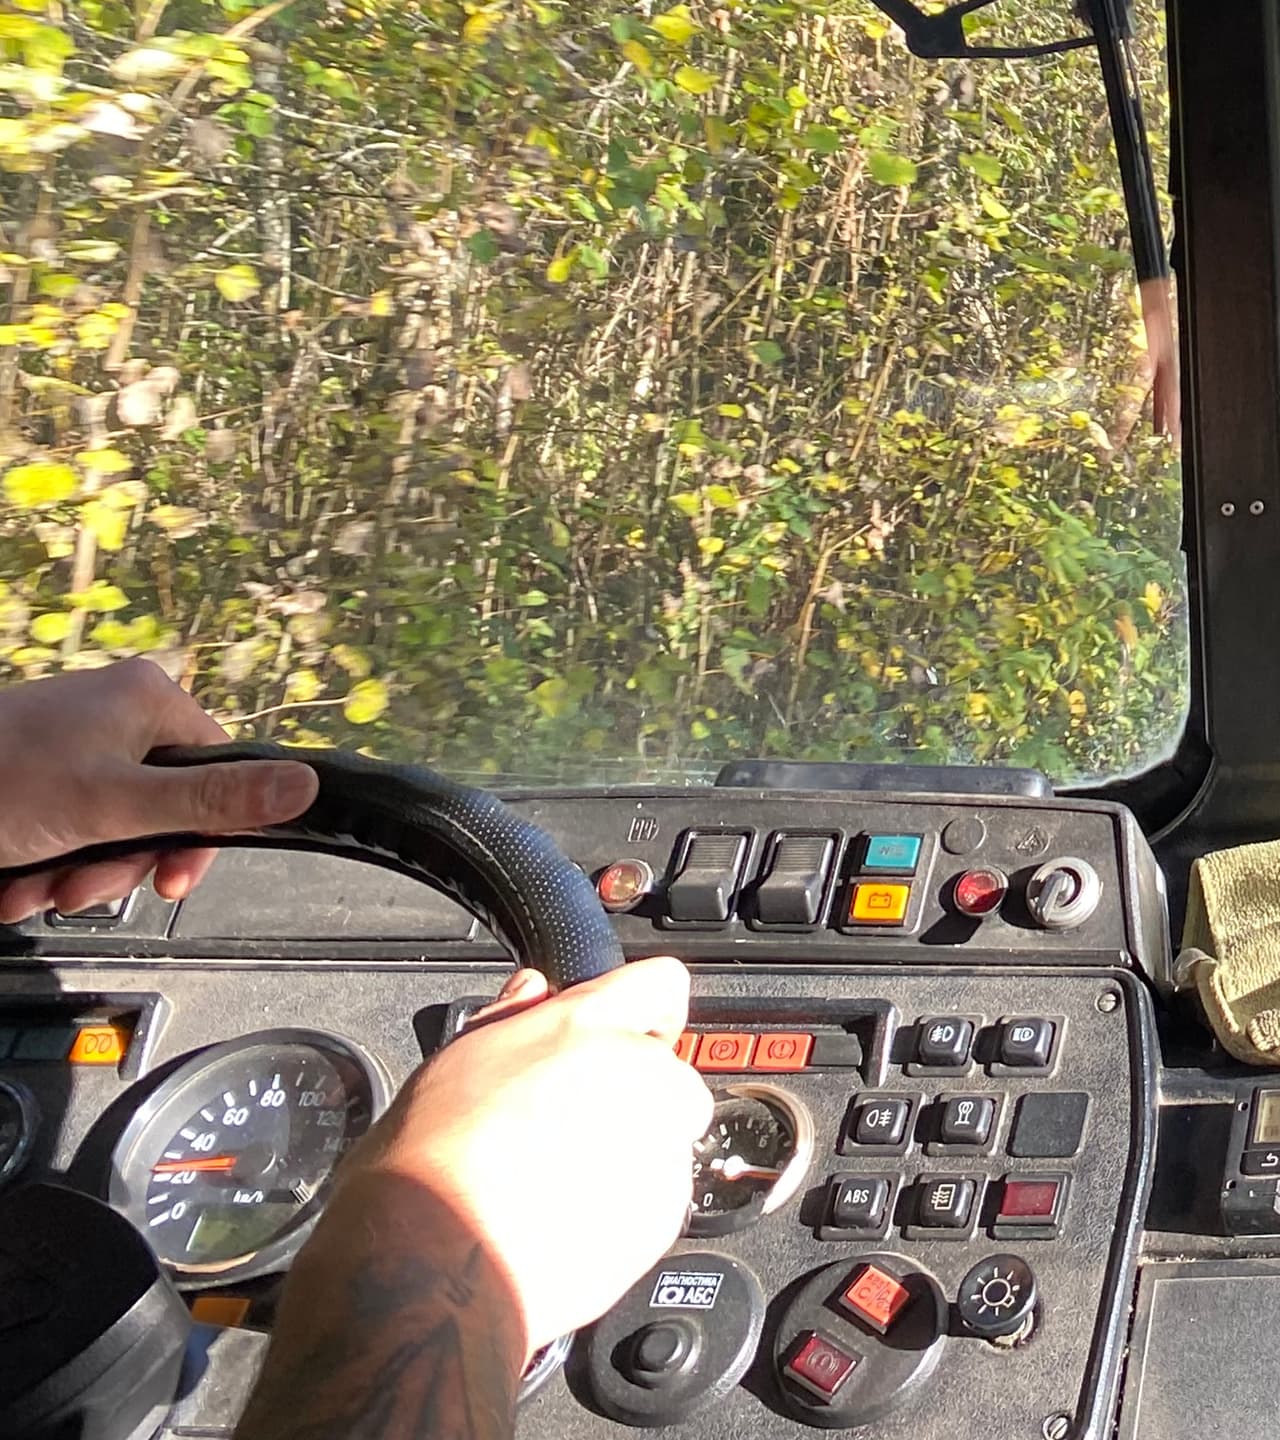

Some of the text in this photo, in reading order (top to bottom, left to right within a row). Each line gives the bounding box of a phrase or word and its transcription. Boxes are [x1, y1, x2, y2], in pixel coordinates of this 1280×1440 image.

[260, 1090, 286, 1107] 80
[298, 1091, 327, 1107] 100
[222, 1108, 249, 1126] 60
[190, 1133, 217, 1151] 40
[721, 1136, 732, 1150] 4
[703, 1193, 713, 1207] 0
[843, 1189, 870, 1204] ABS
[171, 1202, 186, 1220] 0
[660, 1275, 717, 1286] ДИАГНОСТИКА
[682, 1286, 714, 1304] АБС
